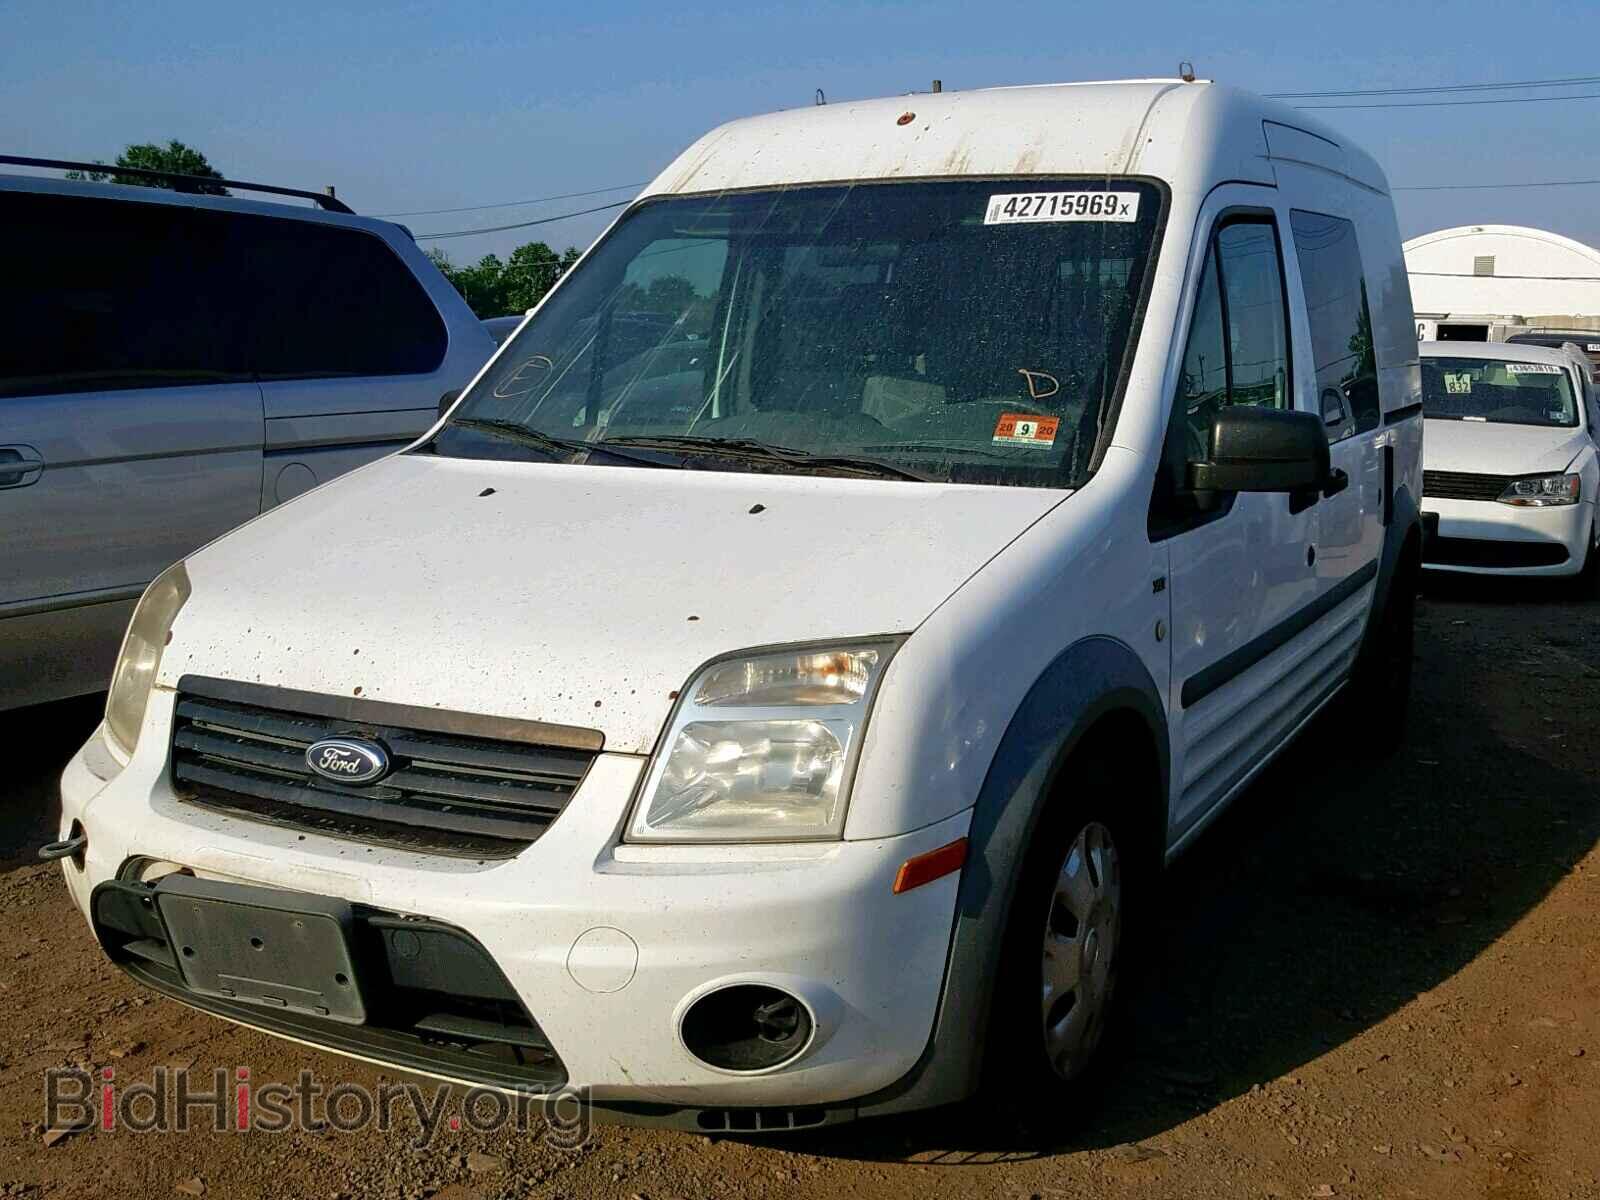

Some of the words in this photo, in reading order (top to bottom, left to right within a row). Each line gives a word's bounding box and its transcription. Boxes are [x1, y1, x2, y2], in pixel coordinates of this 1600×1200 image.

[1018, 368, 1059, 399] D
[1449, 382, 1469, 393] 832
[999, 423, 1013, 432] 20
[1021, 423, 1030, 436] 9
[1039, 426, 1054, 435] 20
[320, 747, 361, 774] Ford
